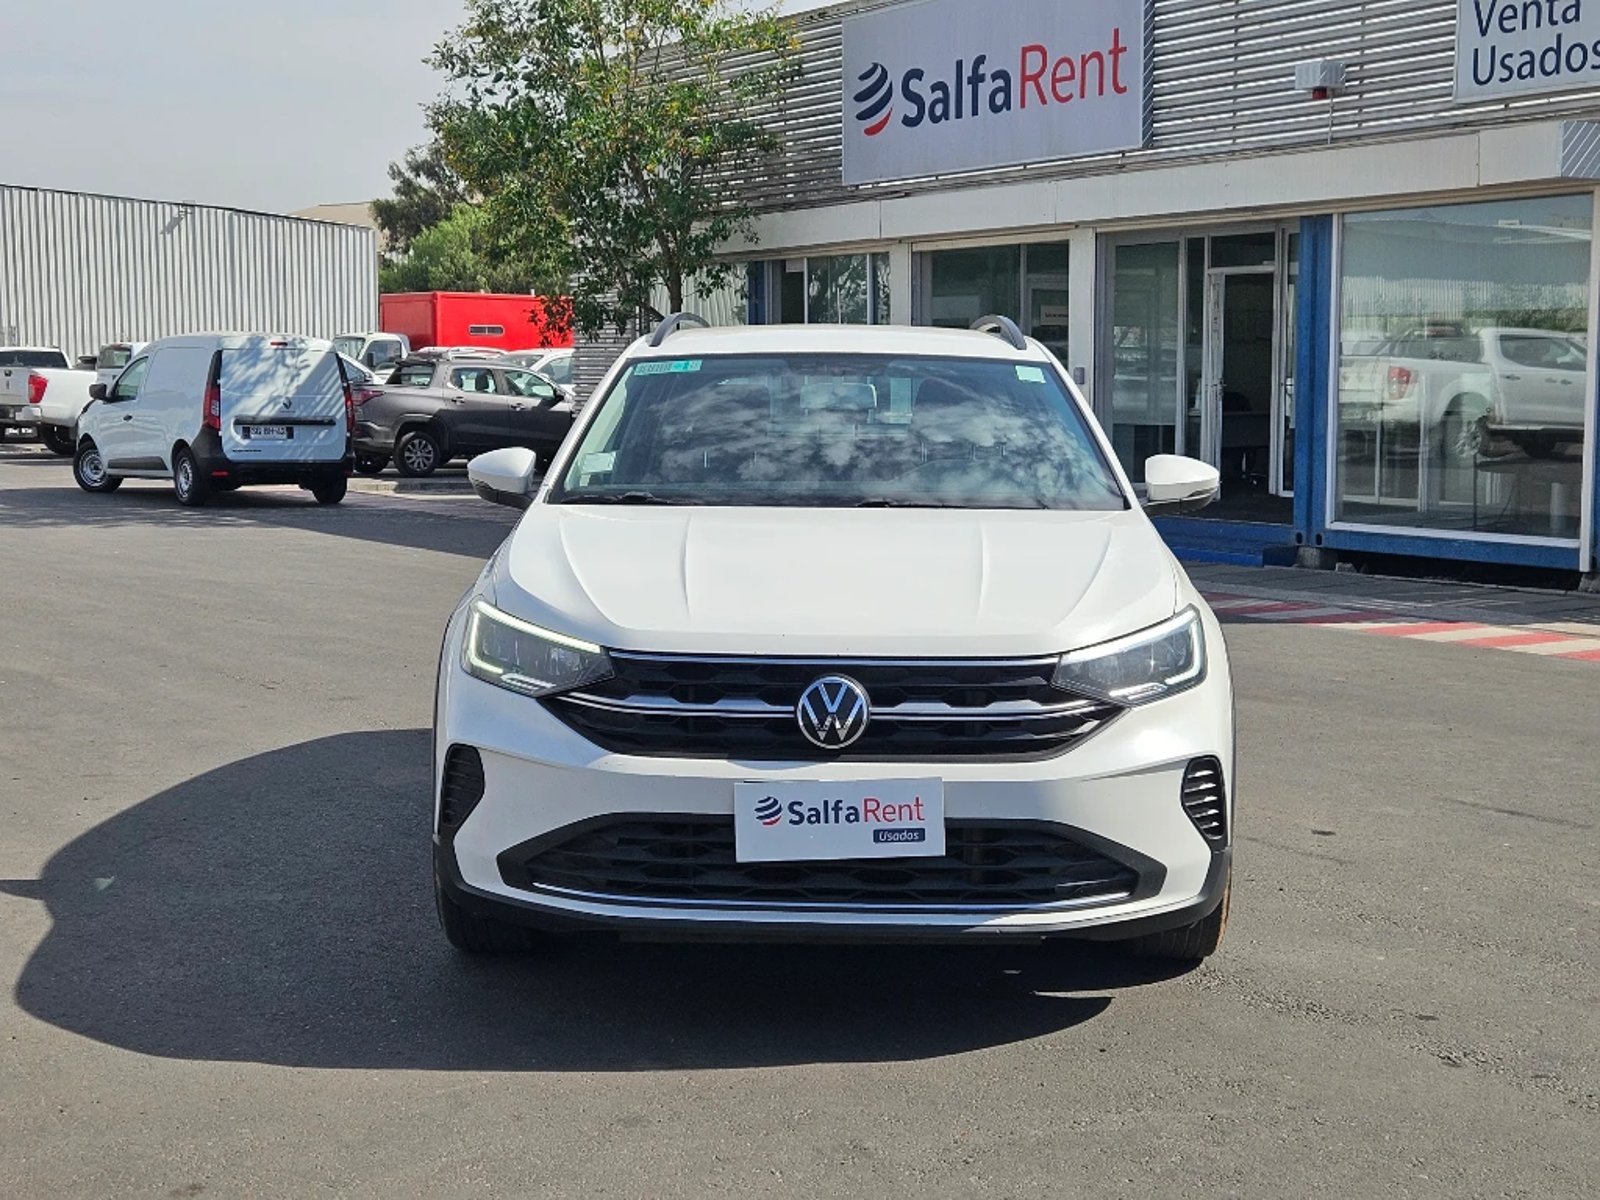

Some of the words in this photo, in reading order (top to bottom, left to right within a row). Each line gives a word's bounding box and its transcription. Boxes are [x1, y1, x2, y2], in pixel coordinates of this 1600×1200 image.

[1474, 0, 1581, 37] Venta
[901, 28, 1127, 128] SalfaRent
[788, 797, 925, 825] SalfaRent
[879, 830, 919, 842] Usados
